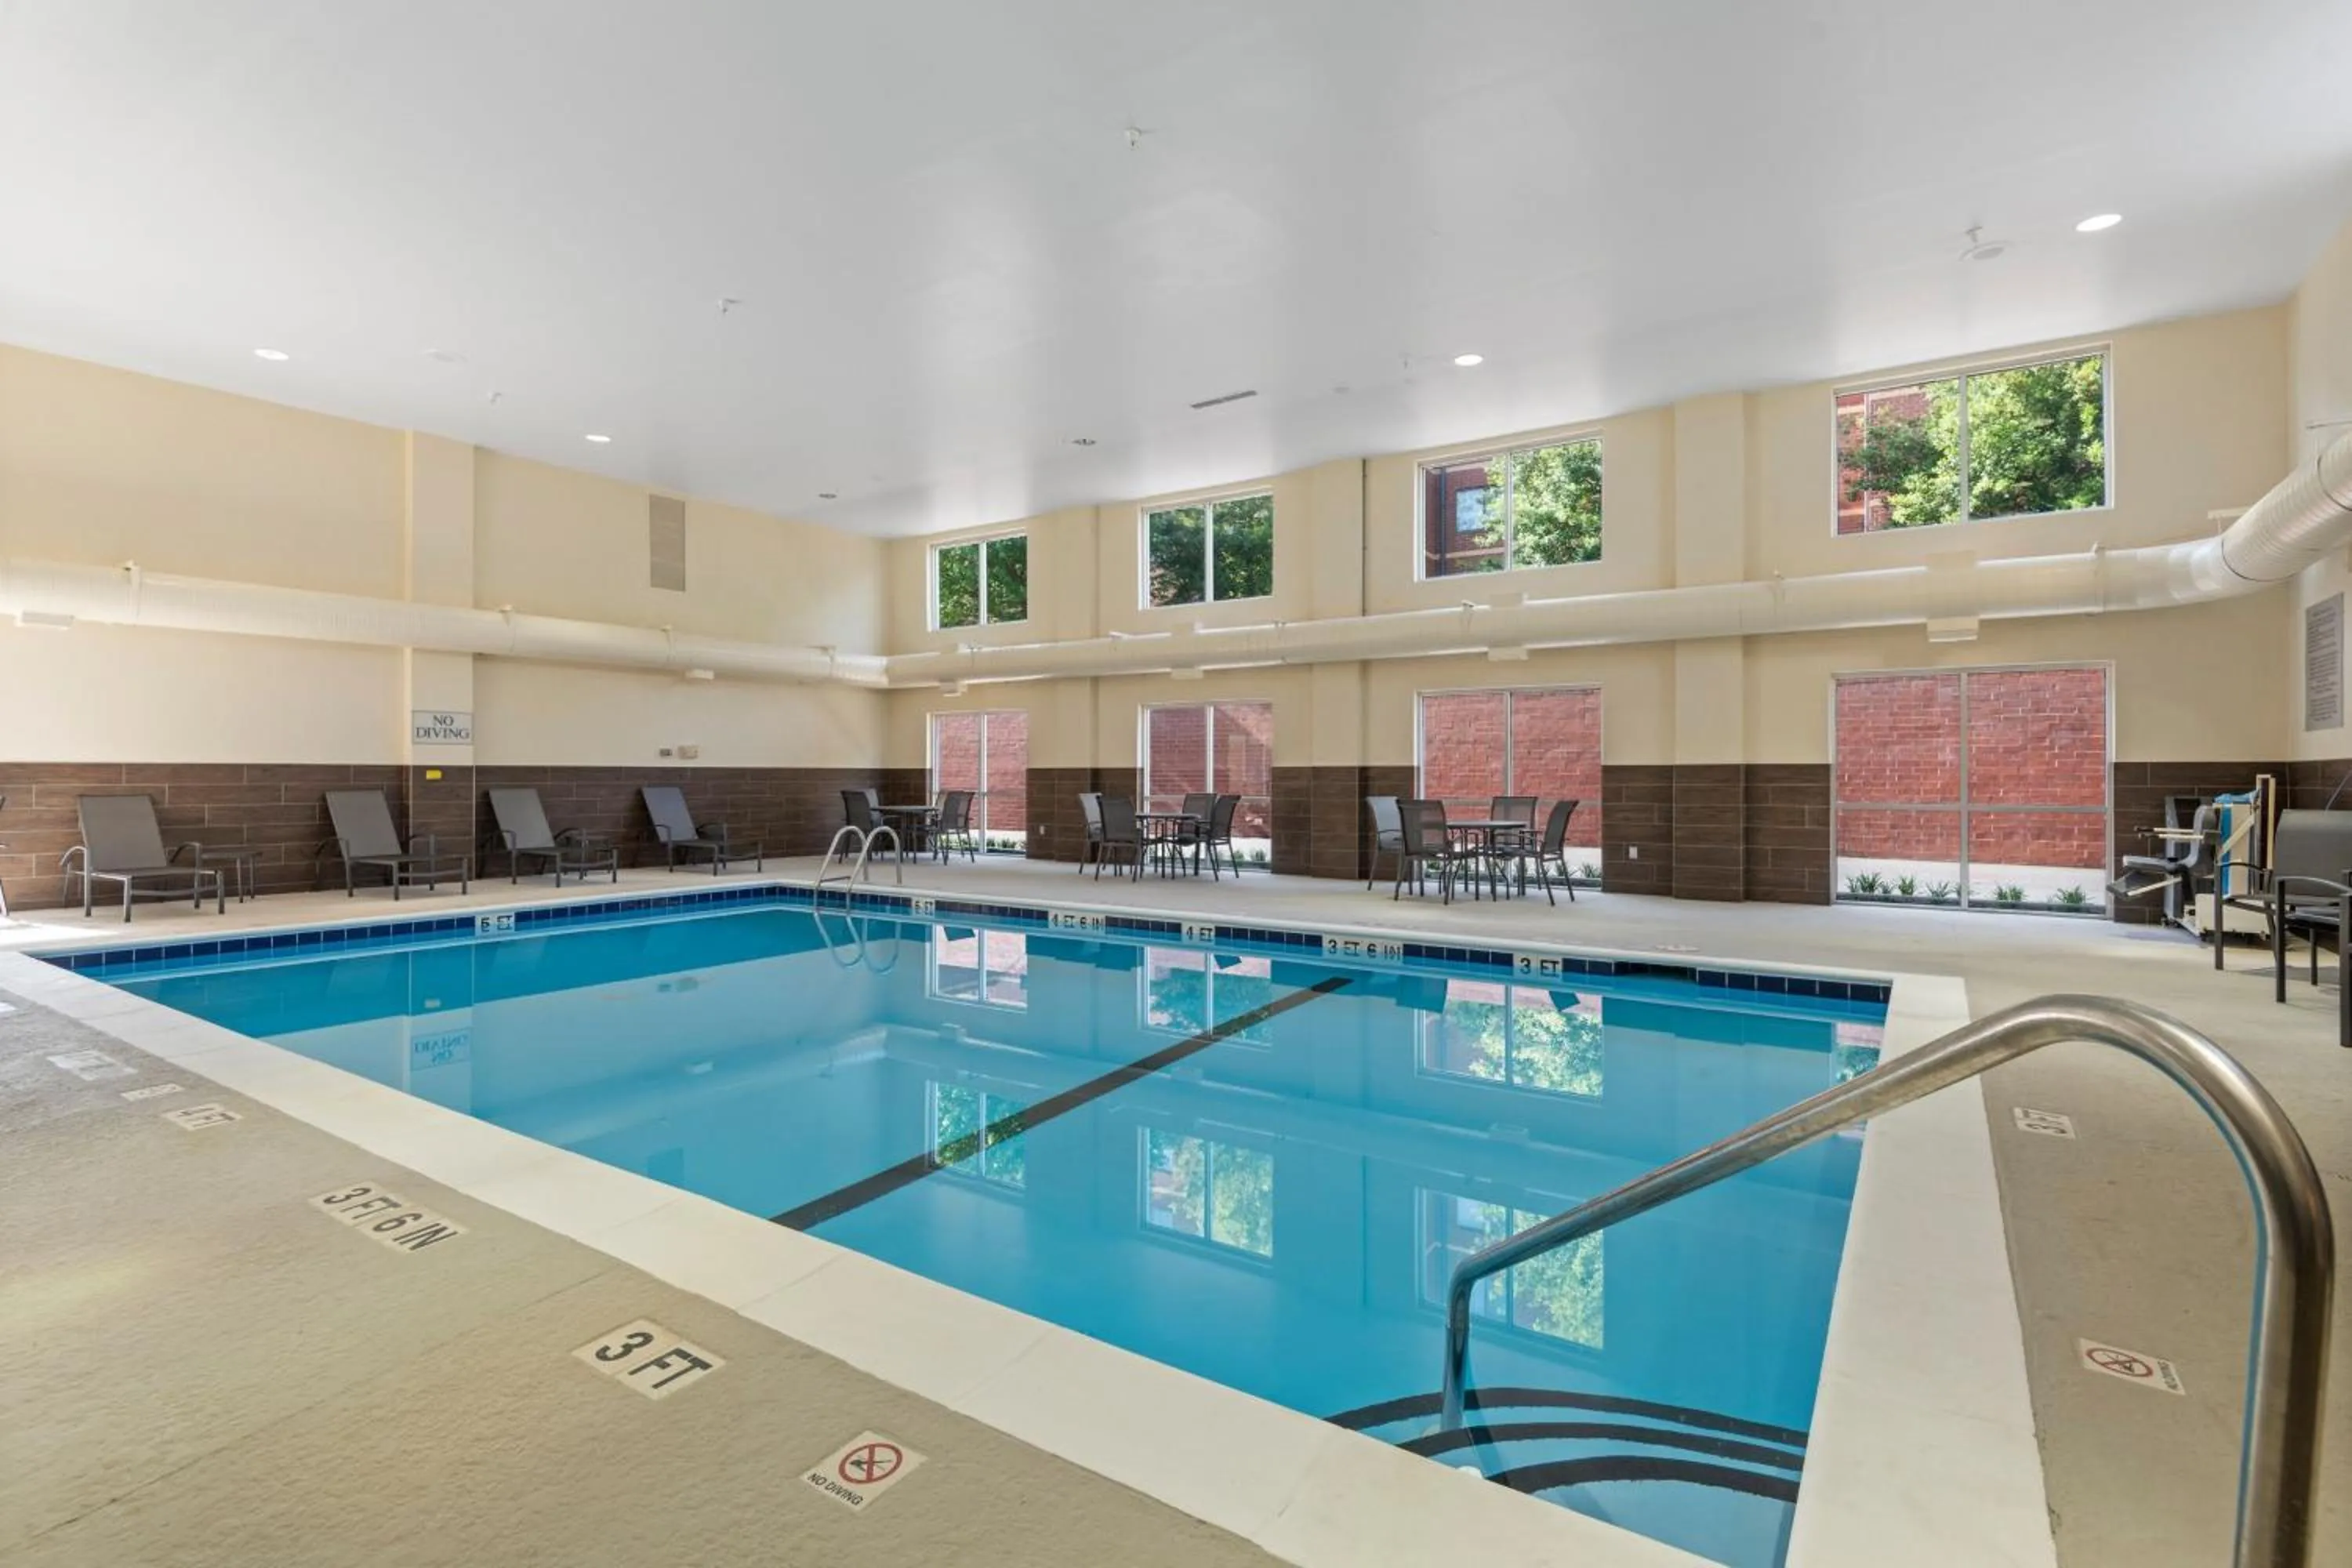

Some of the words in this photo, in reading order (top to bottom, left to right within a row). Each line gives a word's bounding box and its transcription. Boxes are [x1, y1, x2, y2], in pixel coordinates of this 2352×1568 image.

[433, 714, 454, 726] NO
[416, 727, 470, 739] DIVING
[323, 1187, 372, 1204] 3
[339, 1196, 401, 1220] FT
[372, 1213, 423, 1232] 6
[392, 1222, 459, 1250] IN
[595, 1332, 654, 1361] 3
[627, 1347, 713, 1389] FT
[808, 1472, 827, 1486] NO
[826, 1481, 863, 1506] DIVING
